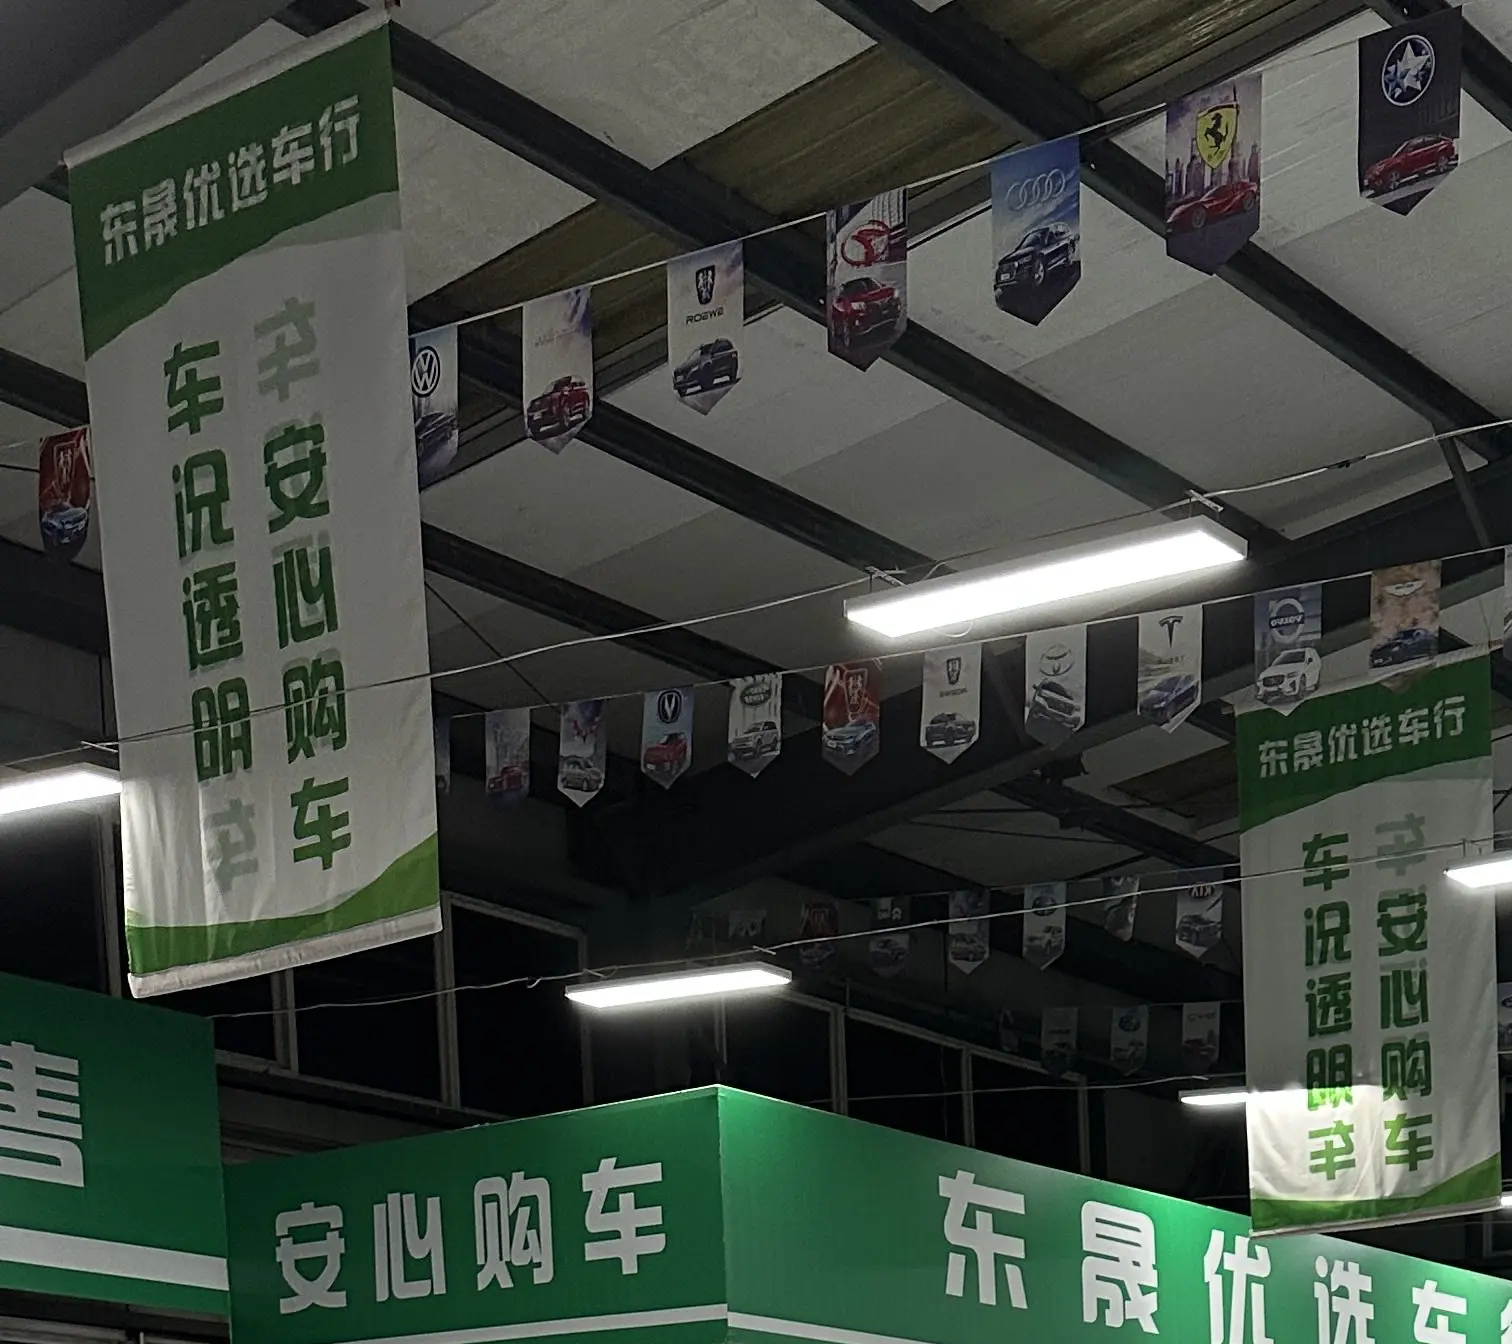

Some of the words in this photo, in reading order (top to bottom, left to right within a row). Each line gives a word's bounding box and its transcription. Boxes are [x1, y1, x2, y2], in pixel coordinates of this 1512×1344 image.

[100, 94, 361, 265] 东晟优选车行
[164, 341, 253, 783] 车况透明
[263, 422, 352, 871] 安心购车
[1258, 695, 1466, 779] 东晟优选车行
[1303, 832, 1354, 1111] 车况透明
[1377, 891, 1434, 1172] 安心购车
[275, 1157, 667, 1315] 安心购车
